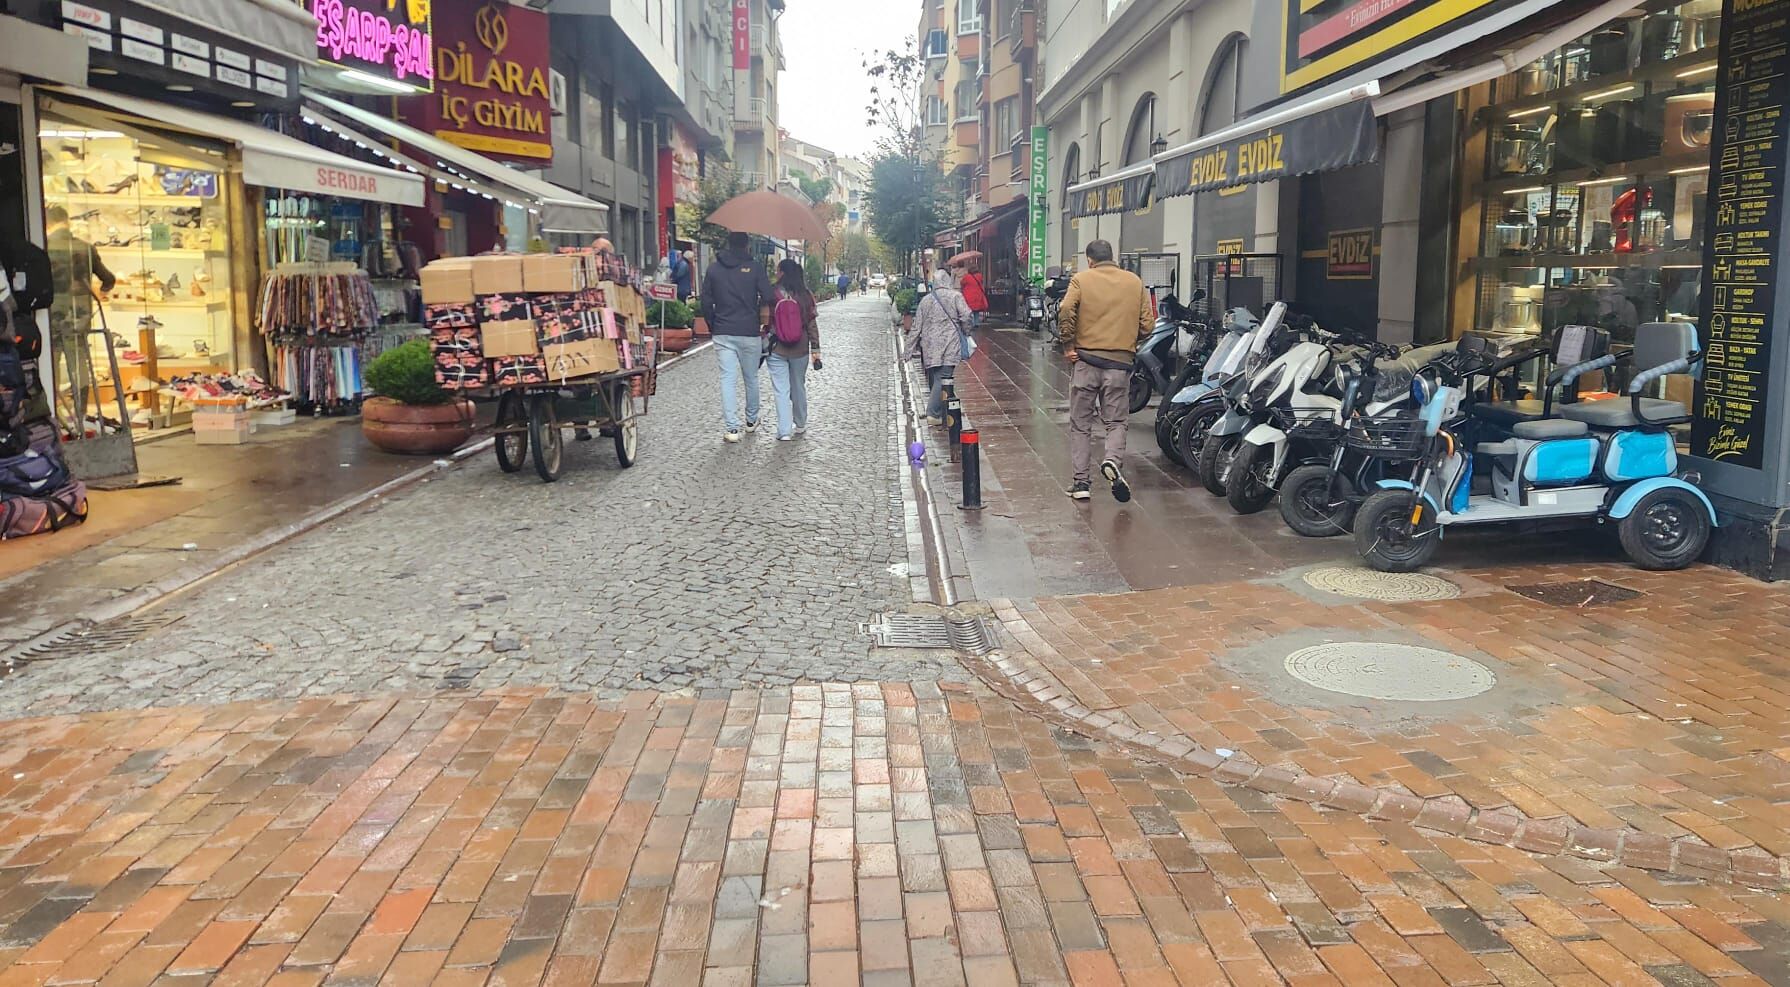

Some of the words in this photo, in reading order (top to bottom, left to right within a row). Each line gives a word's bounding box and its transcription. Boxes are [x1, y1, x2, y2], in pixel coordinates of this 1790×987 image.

[437, 41, 551, 100] DİLARA
[441, 88, 468, 128] İÇ
[474, 98, 546, 134] GİYİM
[317, 168, 377, 193] SERDAR
[1190, 145, 1228, 186] EVDİZ
[1238, 128, 1284, 177] EVDİZ
[1031, 138, 1045, 277] EŞREFLER
